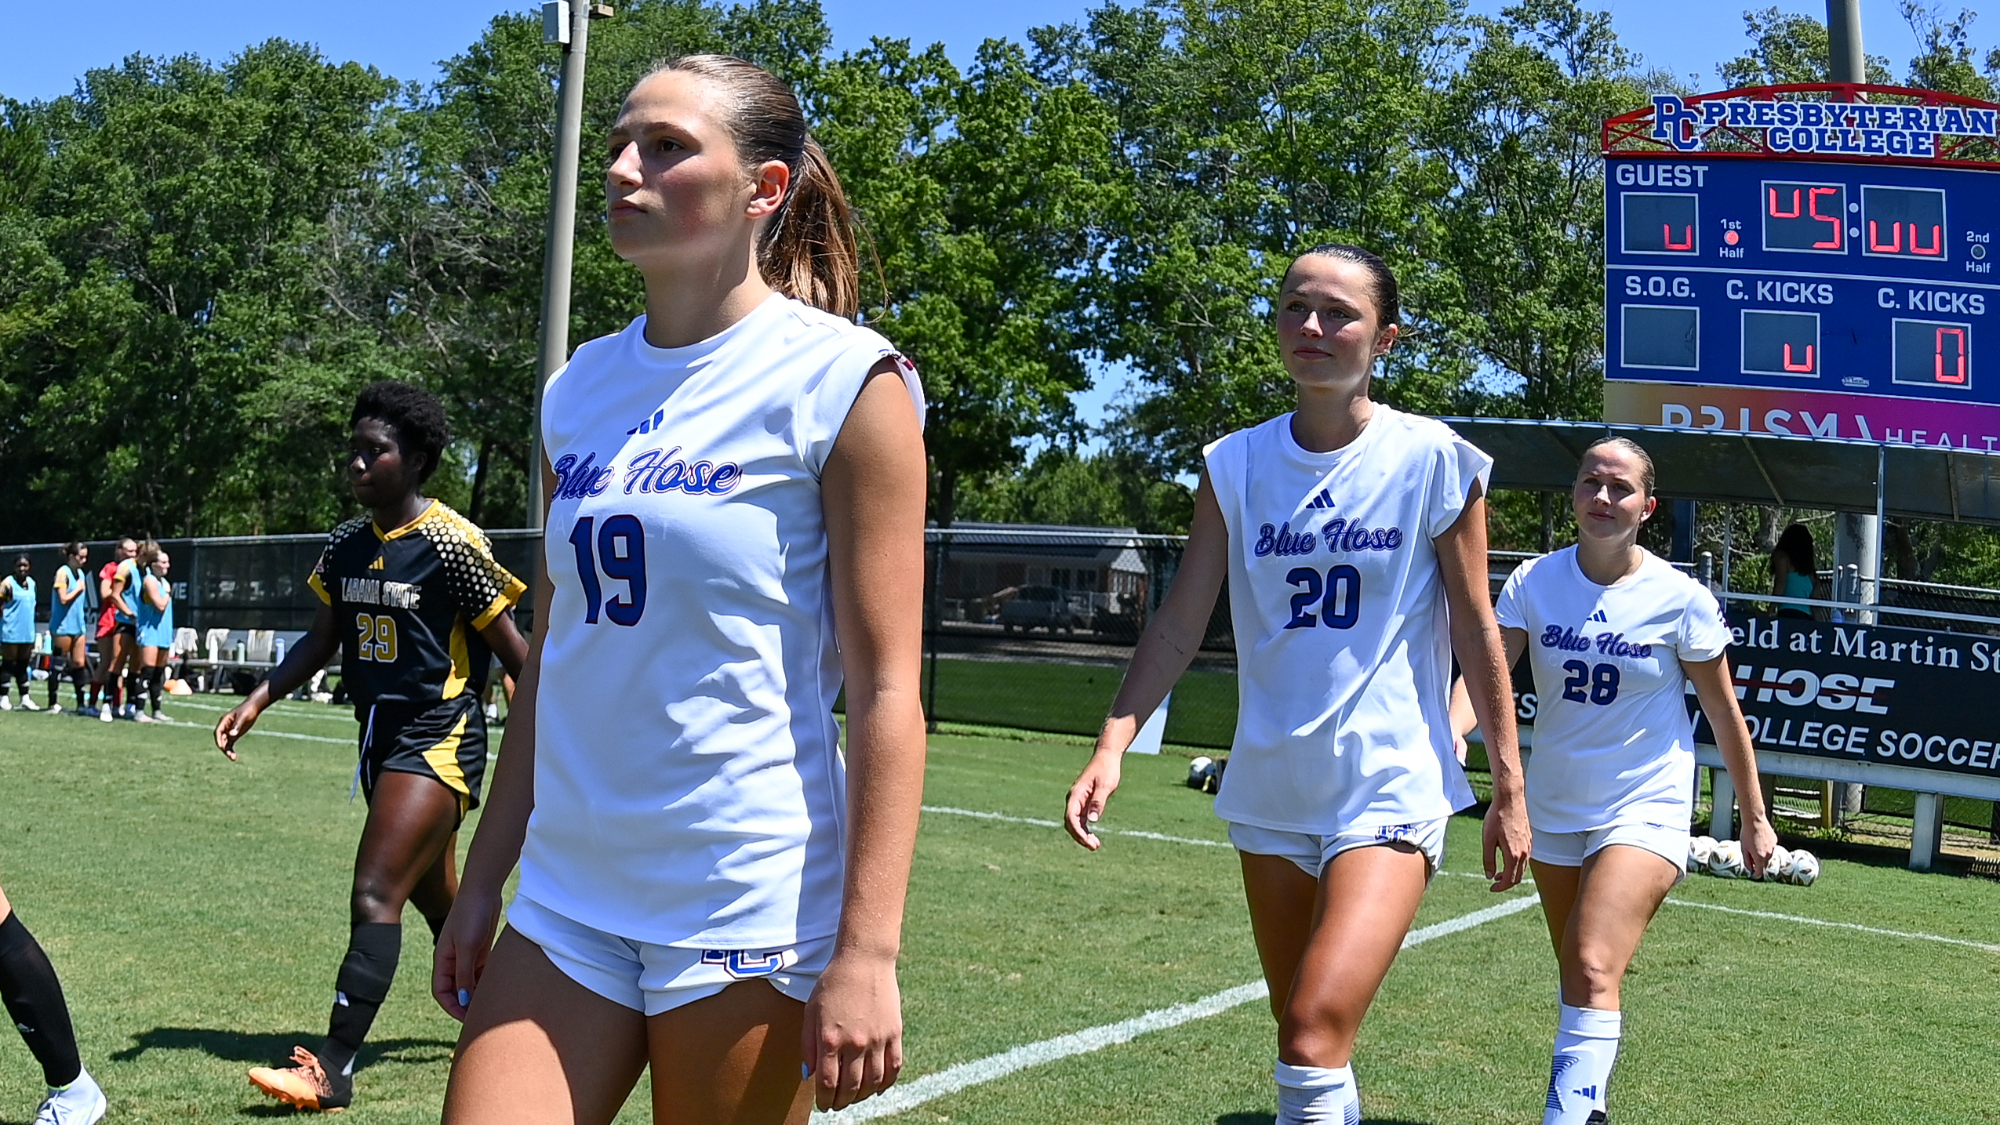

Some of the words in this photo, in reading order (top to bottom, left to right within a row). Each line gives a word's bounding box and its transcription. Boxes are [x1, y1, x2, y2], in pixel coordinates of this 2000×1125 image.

[1702, 101, 1998, 137] PRESBYTERIAN
[1767, 126, 1936, 158] COLLEGE
[1616, 164, 1709, 188] GUEST
[1720, 218, 1742, 231] 1st
[1966, 231, 1990, 243] 2nd
[1719, 247, 1744, 259] Half
[1966, 261, 1991, 273] Half
[1625, 275, 1696, 298] S.O.G.
[1726, 279, 1749, 300] C.
[1757, 280, 1834, 305] KICKS
[1877, 288, 1900, 310] C.
[1908, 289, 1985, 315] KICKS
[1935, 327, 1965, 384] 0
[552, 451, 615, 502] Blue
[623, 445, 743, 496] Hose
[1254, 521, 1317, 557] Blue
[1321, 516, 1403, 553] Hose
[568, 513, 648, 627] 19
[341, 576, 380, 605] LABAMA
[382, 581, 422, 609] STATE
[1282, 564, 1361, 630] 20
[356, 612, 398, 663] 29
[1540, 624, 1591, 652] Blue
[1595, 632, 1653, 658] Hose
[1789, 629, 1822, 654] at
[1831, 626, 1960, 669] Martin
[1562, 659, 1621, 706] 28
[1732, 664, 1896, 715] HOSE
